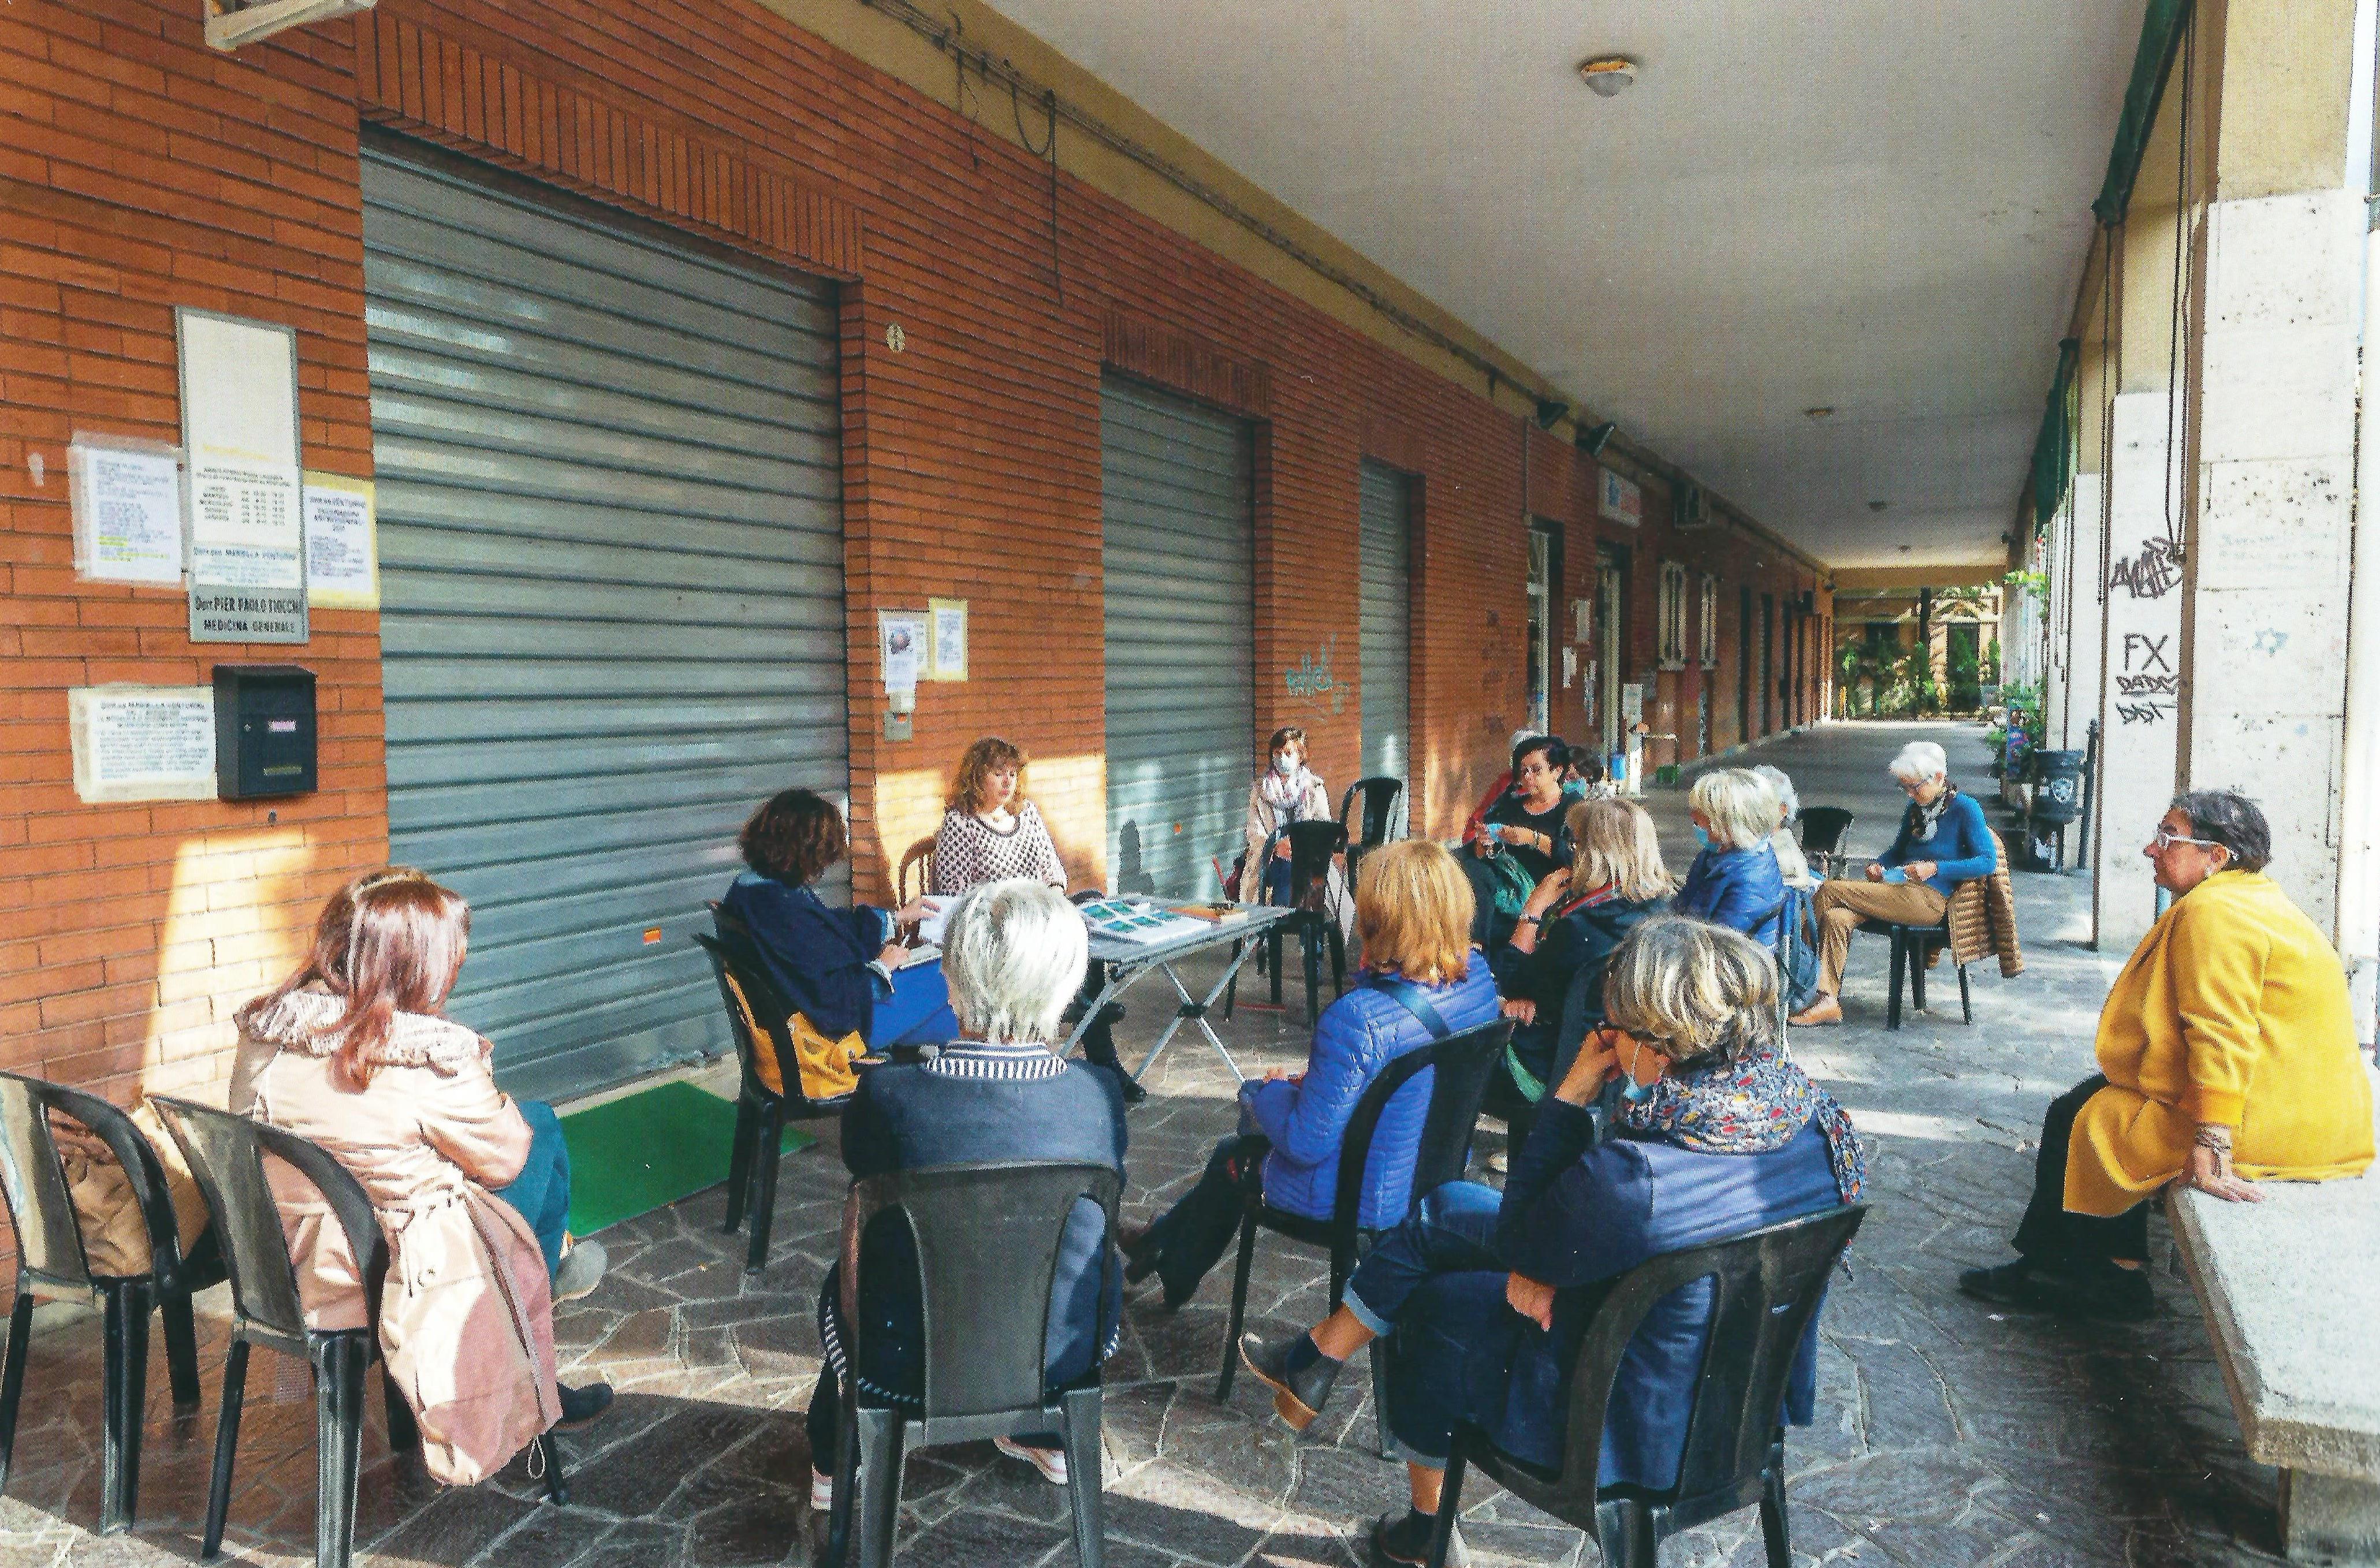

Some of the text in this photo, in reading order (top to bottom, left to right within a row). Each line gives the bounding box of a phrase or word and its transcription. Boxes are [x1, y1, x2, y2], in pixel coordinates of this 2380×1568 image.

[214, 596, 235, 612] PIER
[238, 597, 266, 613] PAOLO
[204, 619, 295, 634] MEDICINA GENERALE
[2124, 633, 2170, 672] FX
